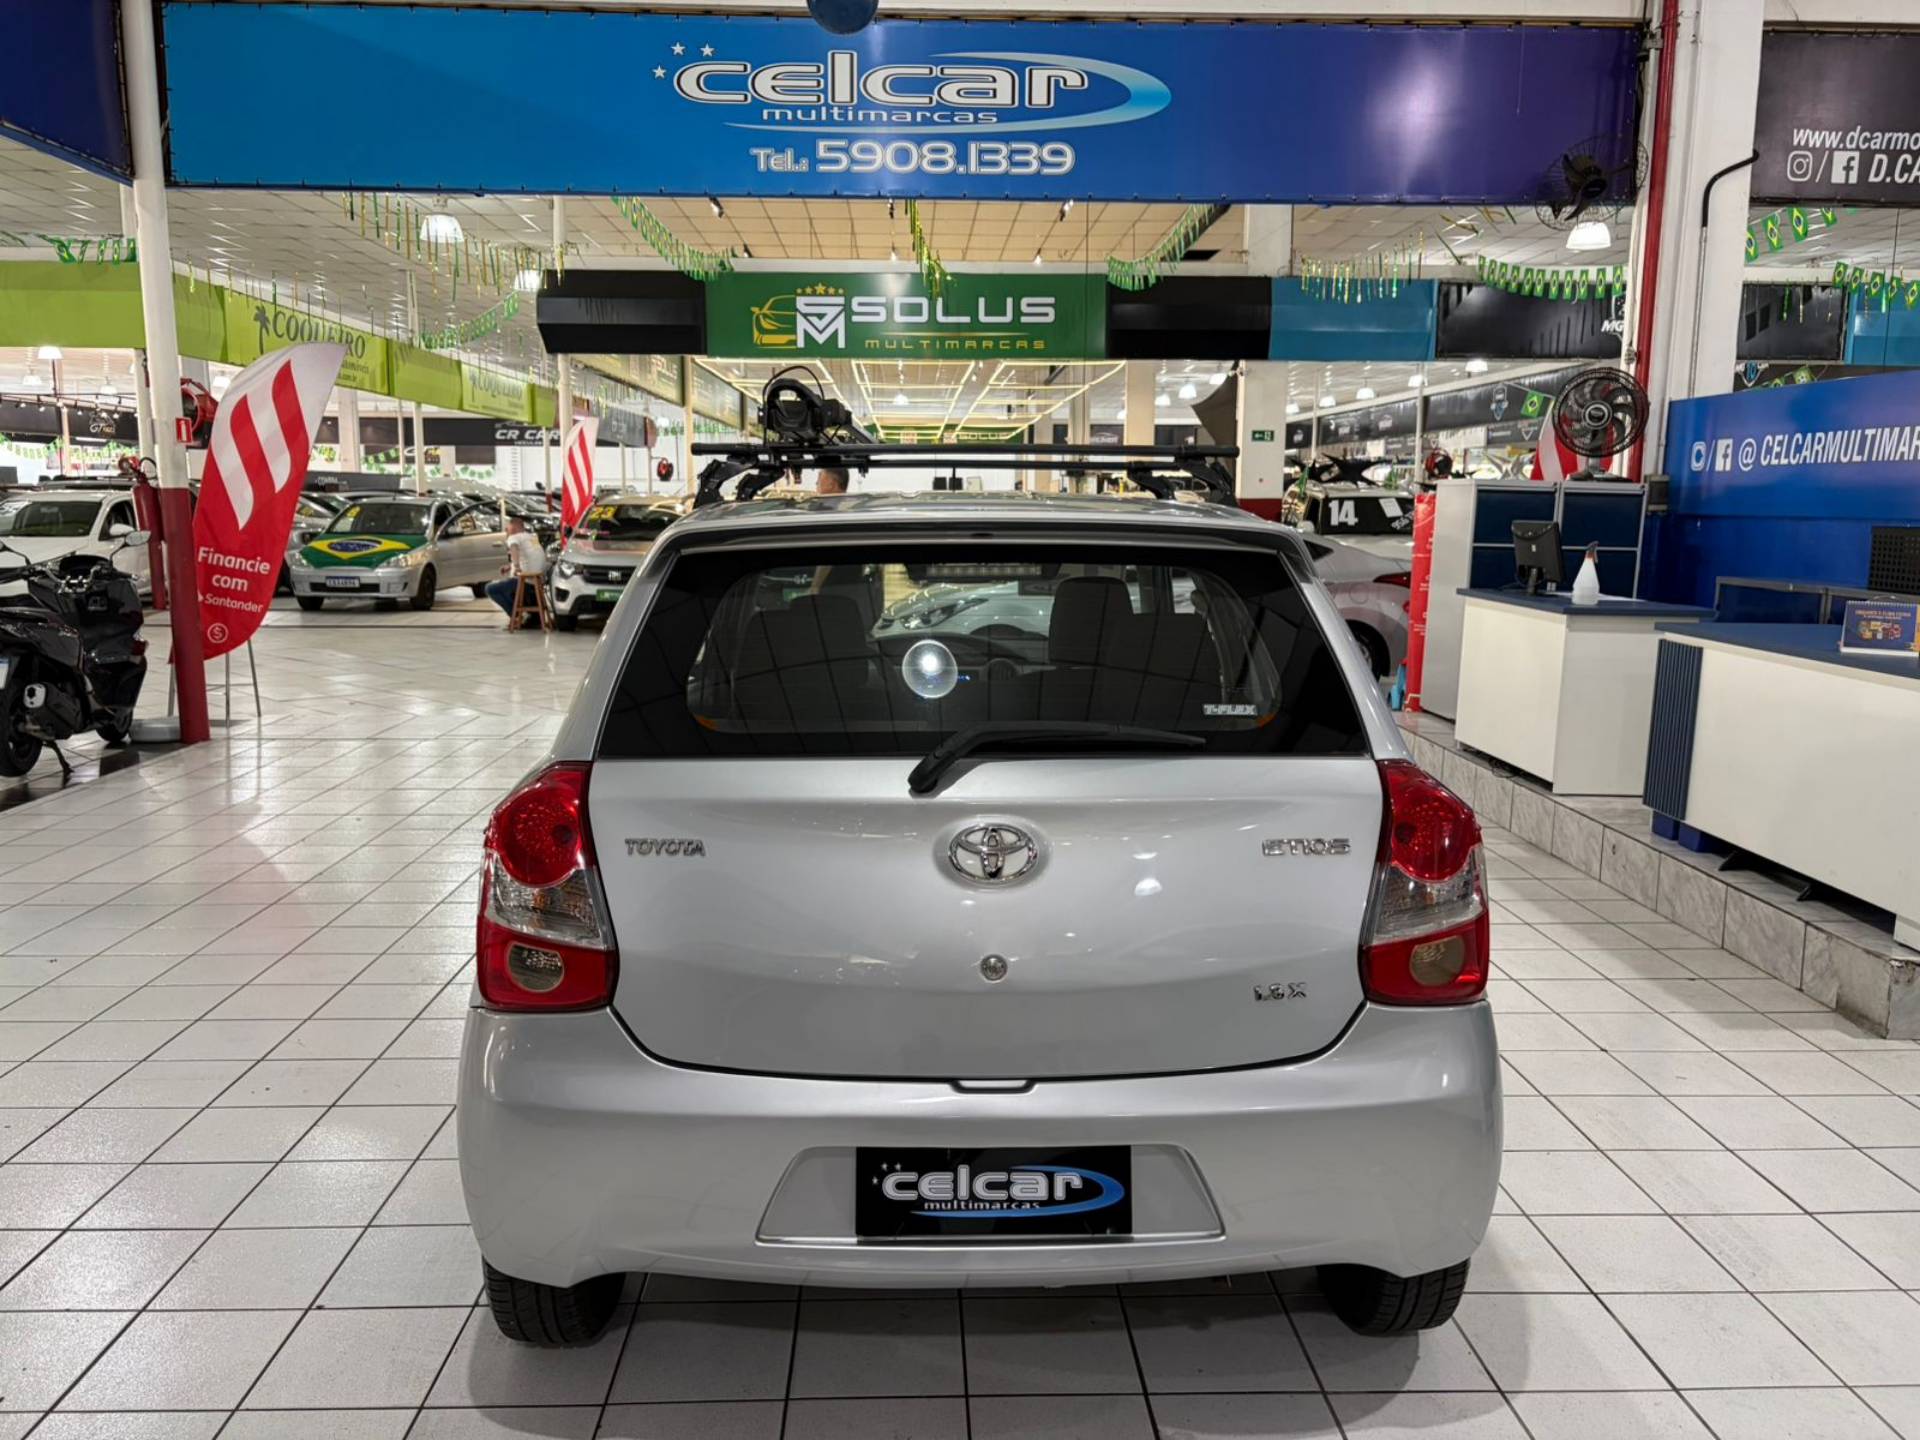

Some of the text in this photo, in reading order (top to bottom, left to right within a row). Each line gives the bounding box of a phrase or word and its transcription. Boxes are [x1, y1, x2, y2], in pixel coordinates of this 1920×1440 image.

[673, 50, 1088, 108] celcar
[762, 105, 998, 124] multimarcas
[816, 139, 1075, 175] 5908.1339
[851, 296, 1056, 323] SOLUS
[865, 339, 1049, 350] MULTIMARCAS
[494, 429, 520, 440] CR
[1328, 499, 1358, 527] 14
[198, 546, 271, 575] Financie
[212, 574, 249, 592] com
[204, 592, 264, 613] Santander
[624, 838, 707, 857] TOYOTA
[1262, 838, 1351, 857] ETIOS
[881, 1164, 1084, 1201] celcar
[924, 1200, 1041, 1211] multimarcas
